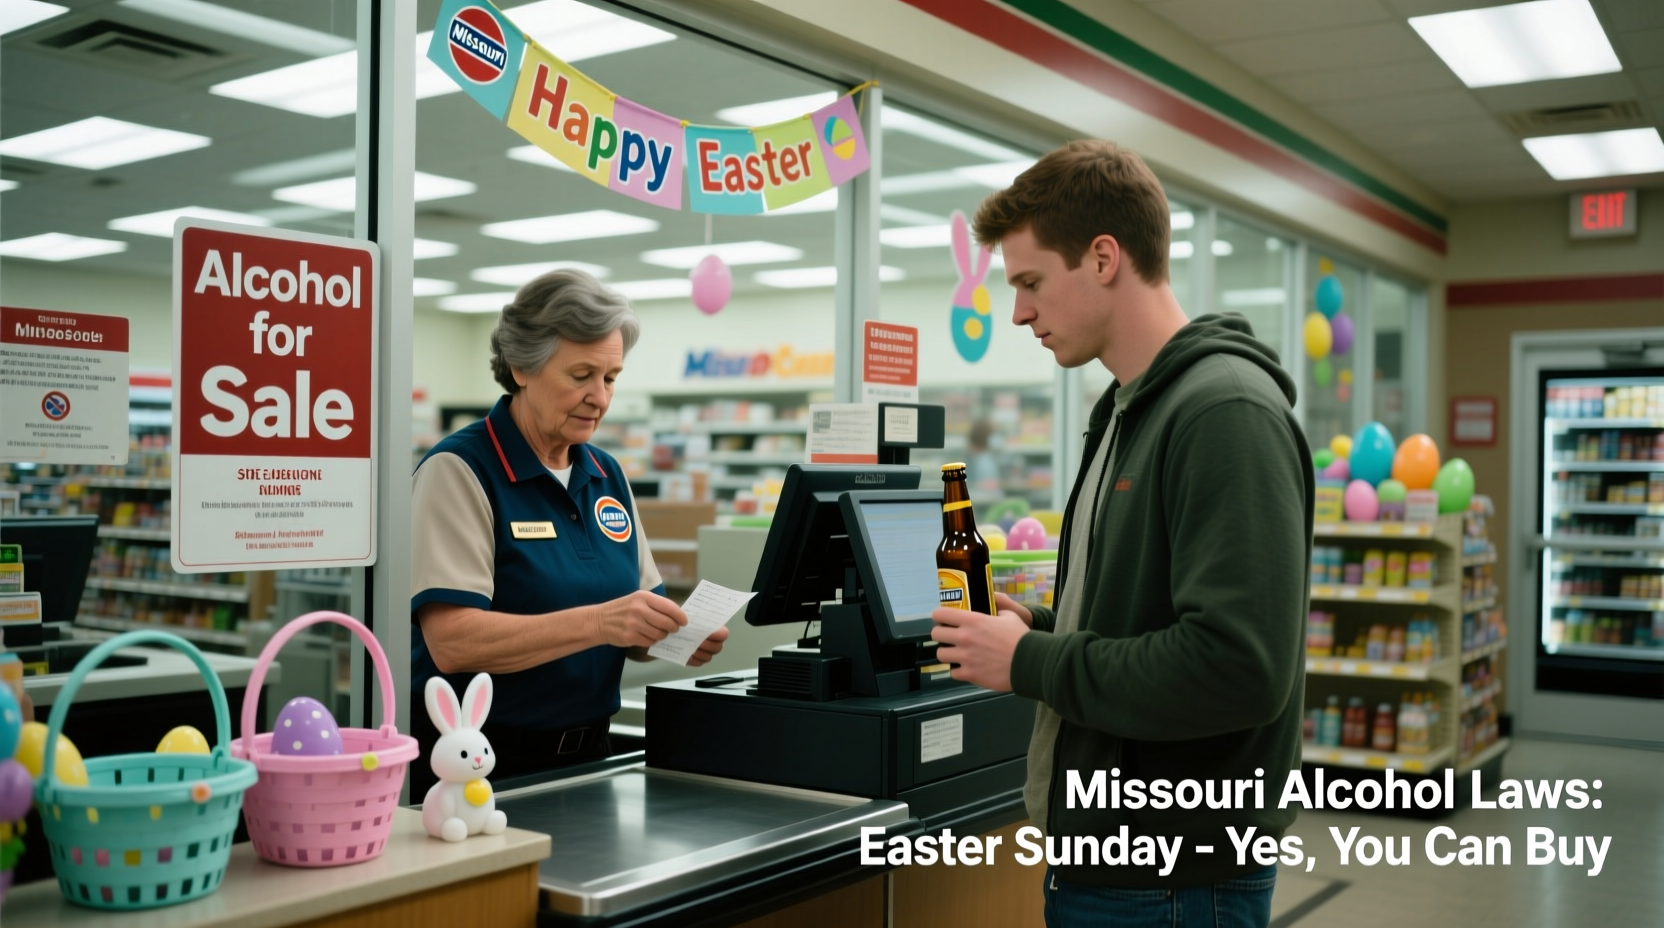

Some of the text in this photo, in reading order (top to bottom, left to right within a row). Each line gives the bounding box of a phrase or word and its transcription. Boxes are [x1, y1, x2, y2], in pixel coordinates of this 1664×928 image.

[528, 63, 813, 194] Happy Easter
[194, 248, 361, 309] Alcohol
[249, 310, 313, 357] for
[199, 365, 355, 441] Sale
